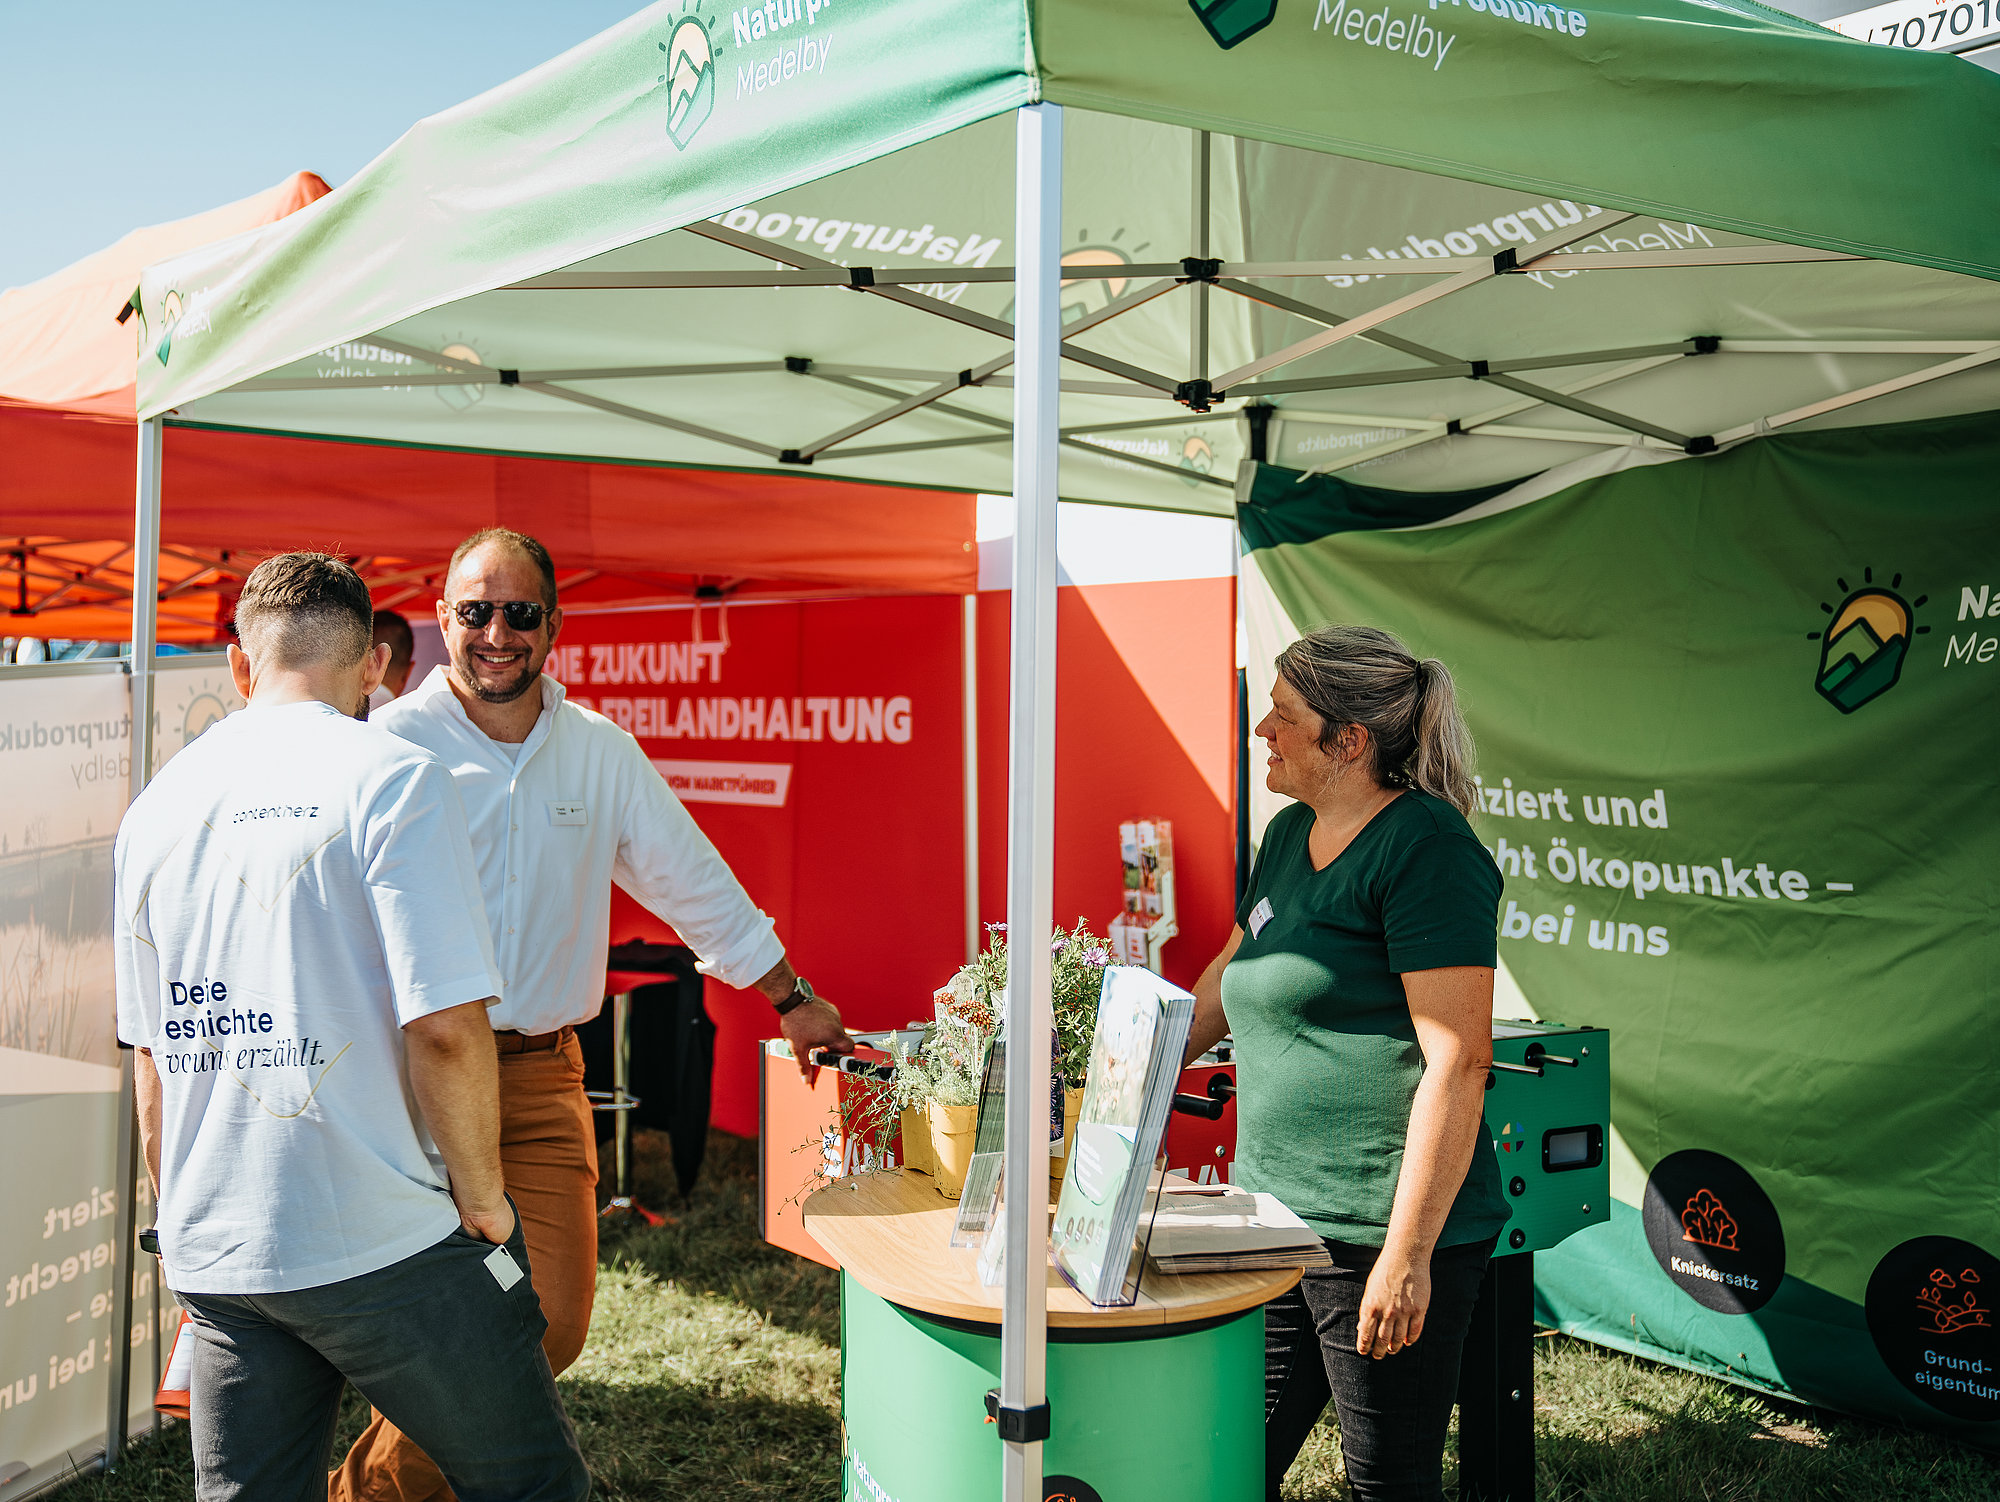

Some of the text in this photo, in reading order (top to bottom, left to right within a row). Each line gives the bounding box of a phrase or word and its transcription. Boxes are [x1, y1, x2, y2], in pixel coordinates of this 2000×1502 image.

[732, 0, 830, 48] Naturp
[1313, 0, 1456, 71] Medelby
[736, 33, 834, 100] Medelby
[589, 641, 728, 683] ZUKUNFT
[601, 696, 912, 743] FREILANDHALTUNG
[1582, 788, 1669, 829] und
[1547, 836, 1811, 901] Ökopunkte
[1500, 900, 1671, 957] bei uns
[236, 1037, 325, 1070] erzählt.
[1670, 1255, 1760, 1291] Knickersatz
[1924, 1349, 1993, 1374] Grund-
[1915, 1370, 2000, 1401] eigentum
